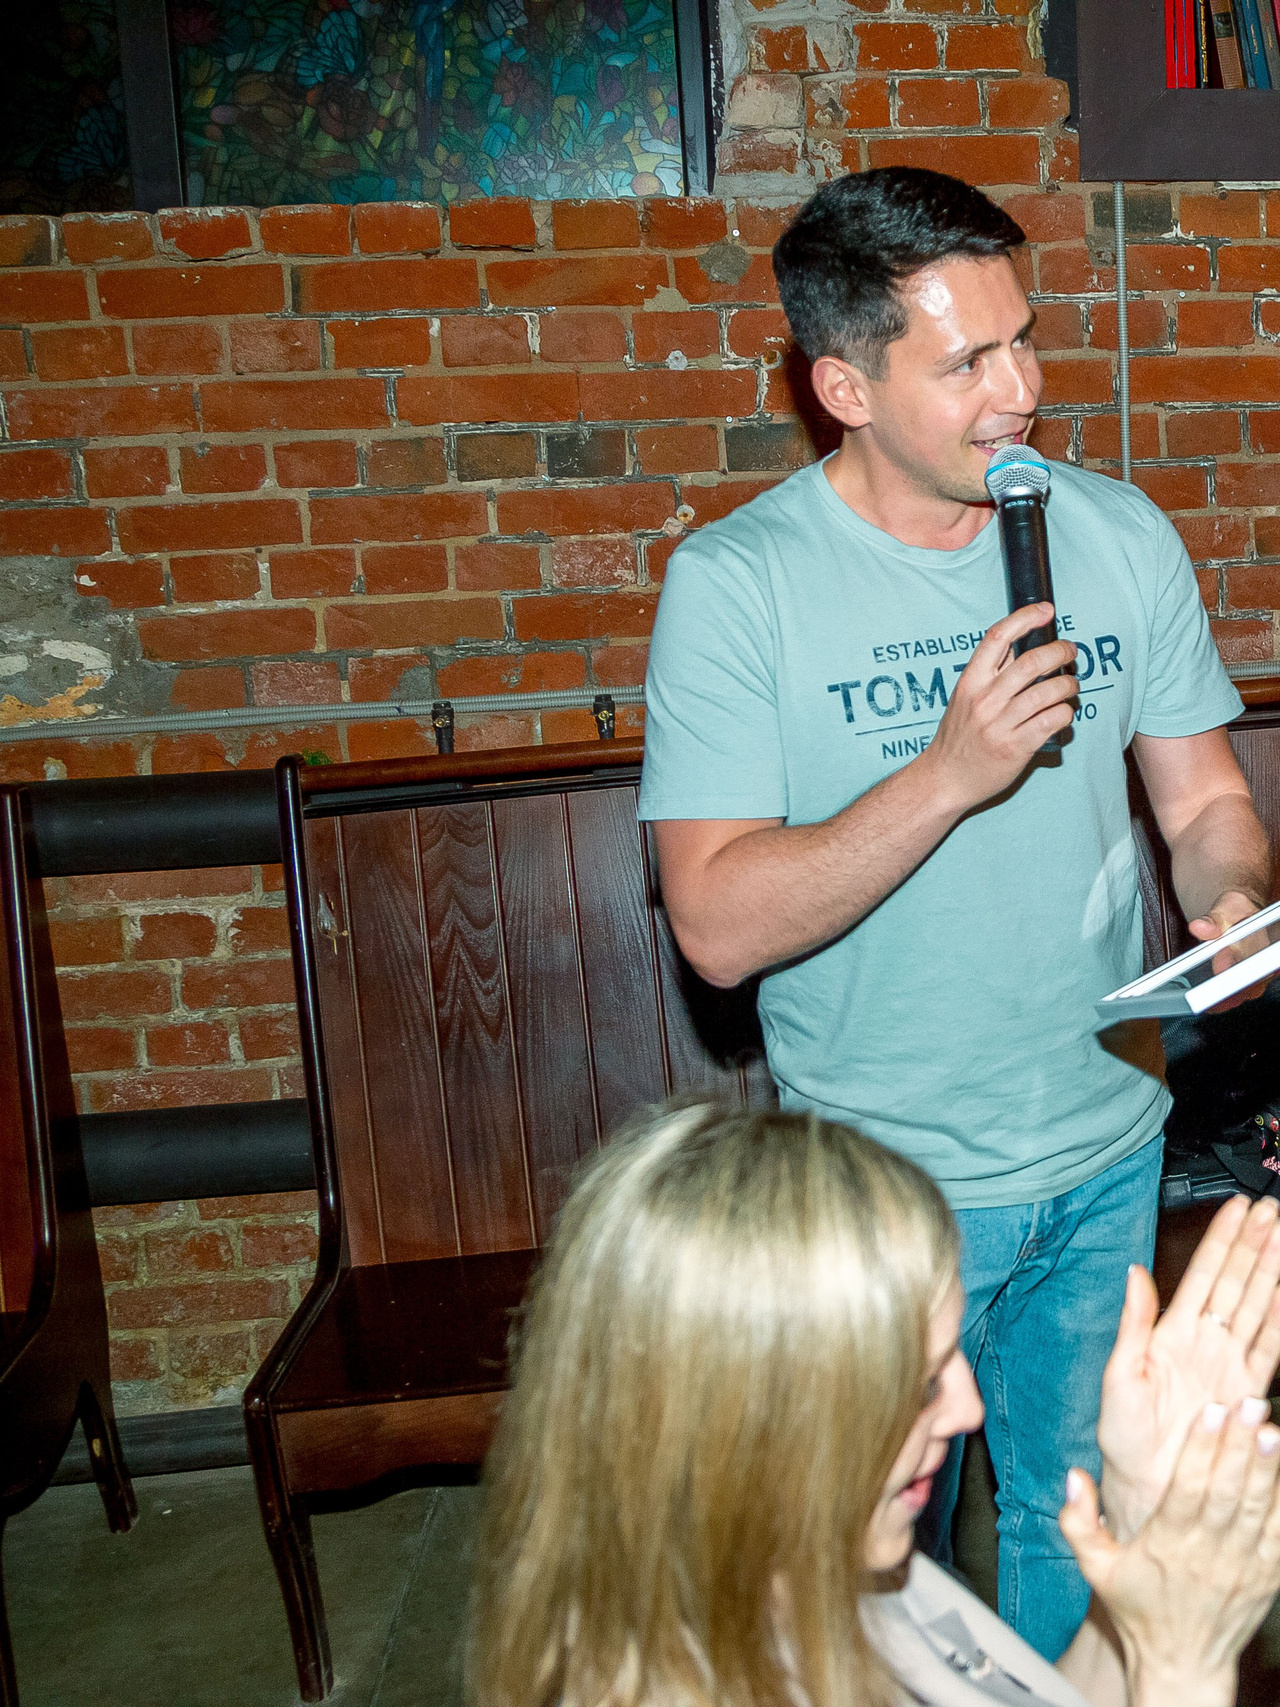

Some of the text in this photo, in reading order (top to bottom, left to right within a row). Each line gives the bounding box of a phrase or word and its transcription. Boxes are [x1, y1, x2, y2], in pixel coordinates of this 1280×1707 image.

[872, 629, 987, 663] ESTABLISH
[826, 666, 949, 723] TOM
[881, 733, 934, 760] NINE
